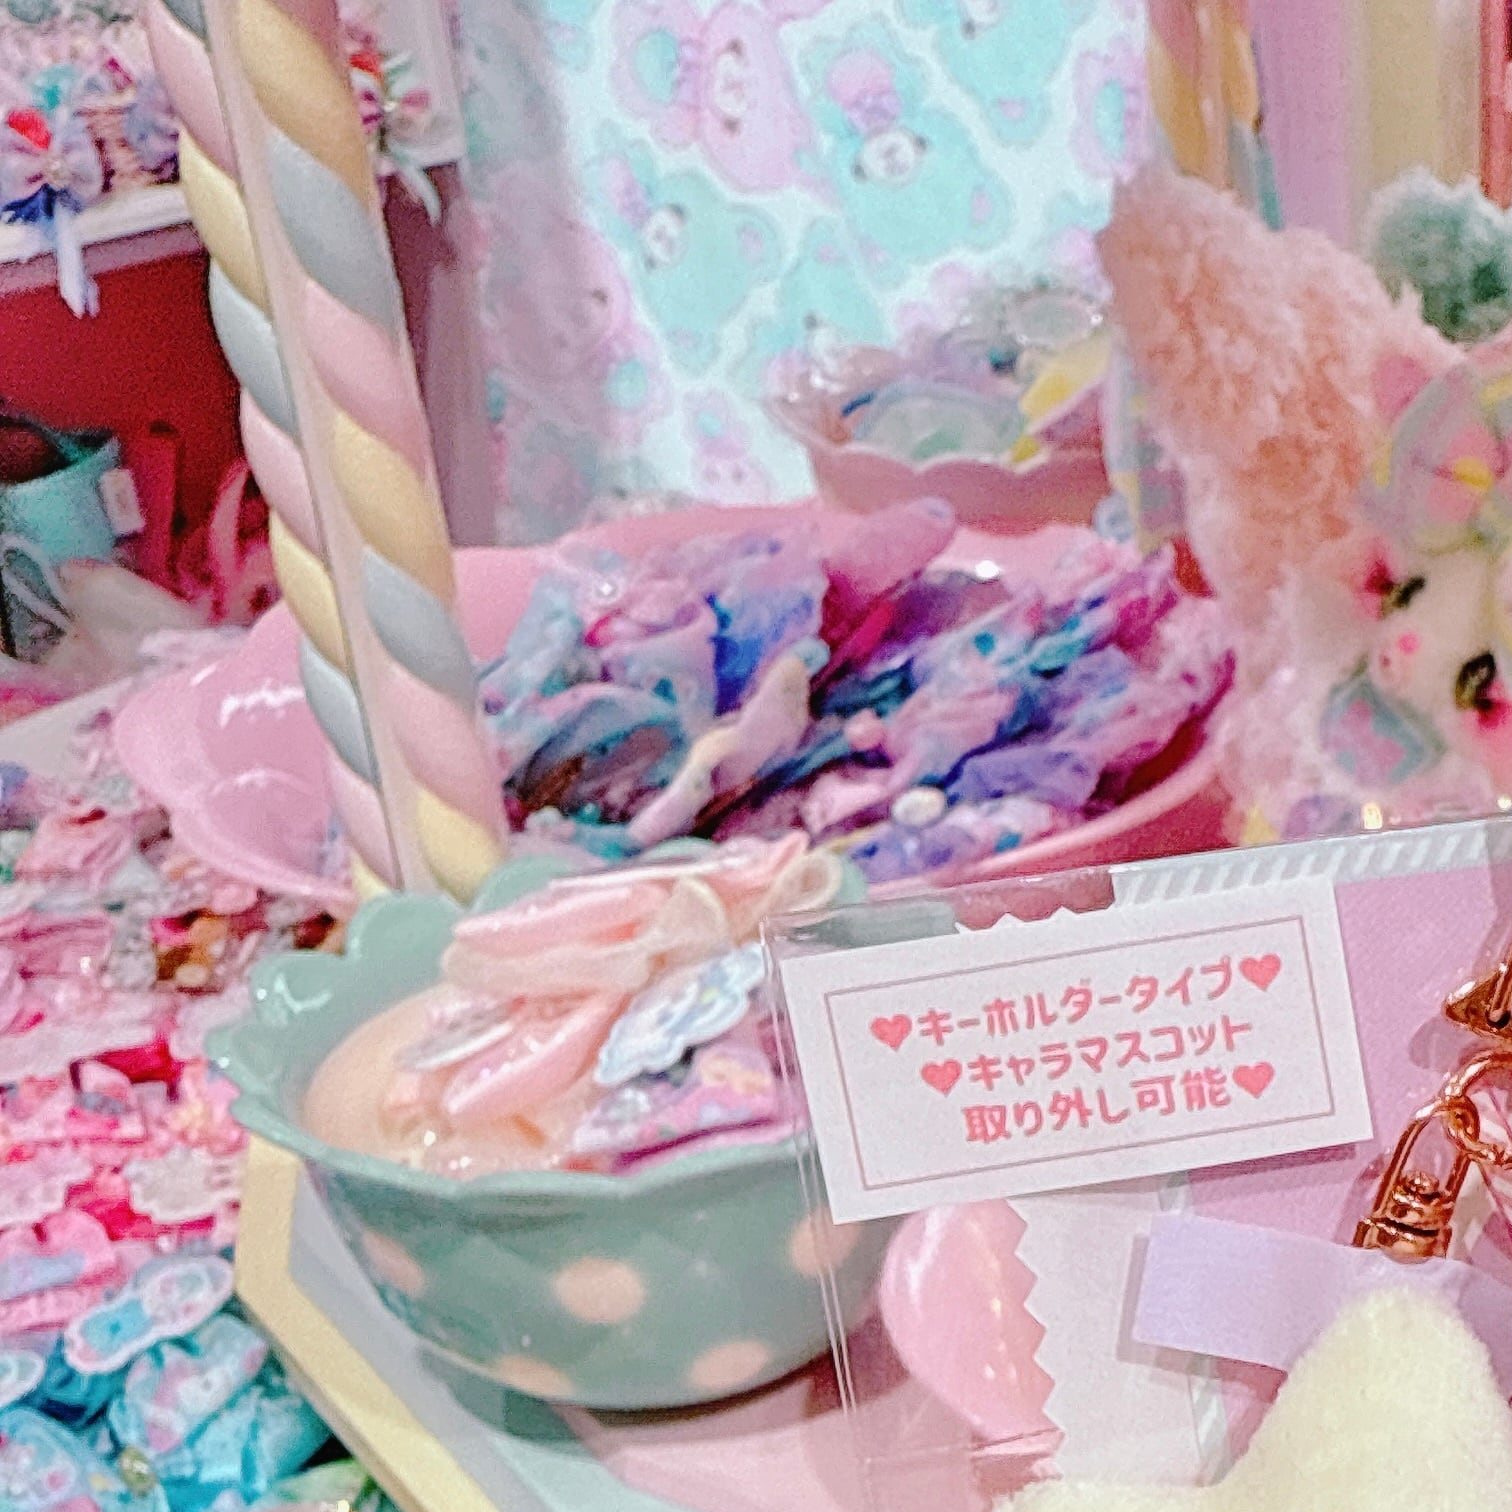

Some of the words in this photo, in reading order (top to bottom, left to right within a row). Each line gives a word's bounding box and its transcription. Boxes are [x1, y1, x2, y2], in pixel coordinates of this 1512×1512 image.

[917, 955, 1233, 1047] キーホルダータイプ
[966, 1015, 1252, 1090] キャラマスコット
[963, 1068, 1232, 1145] 取り外し可能
